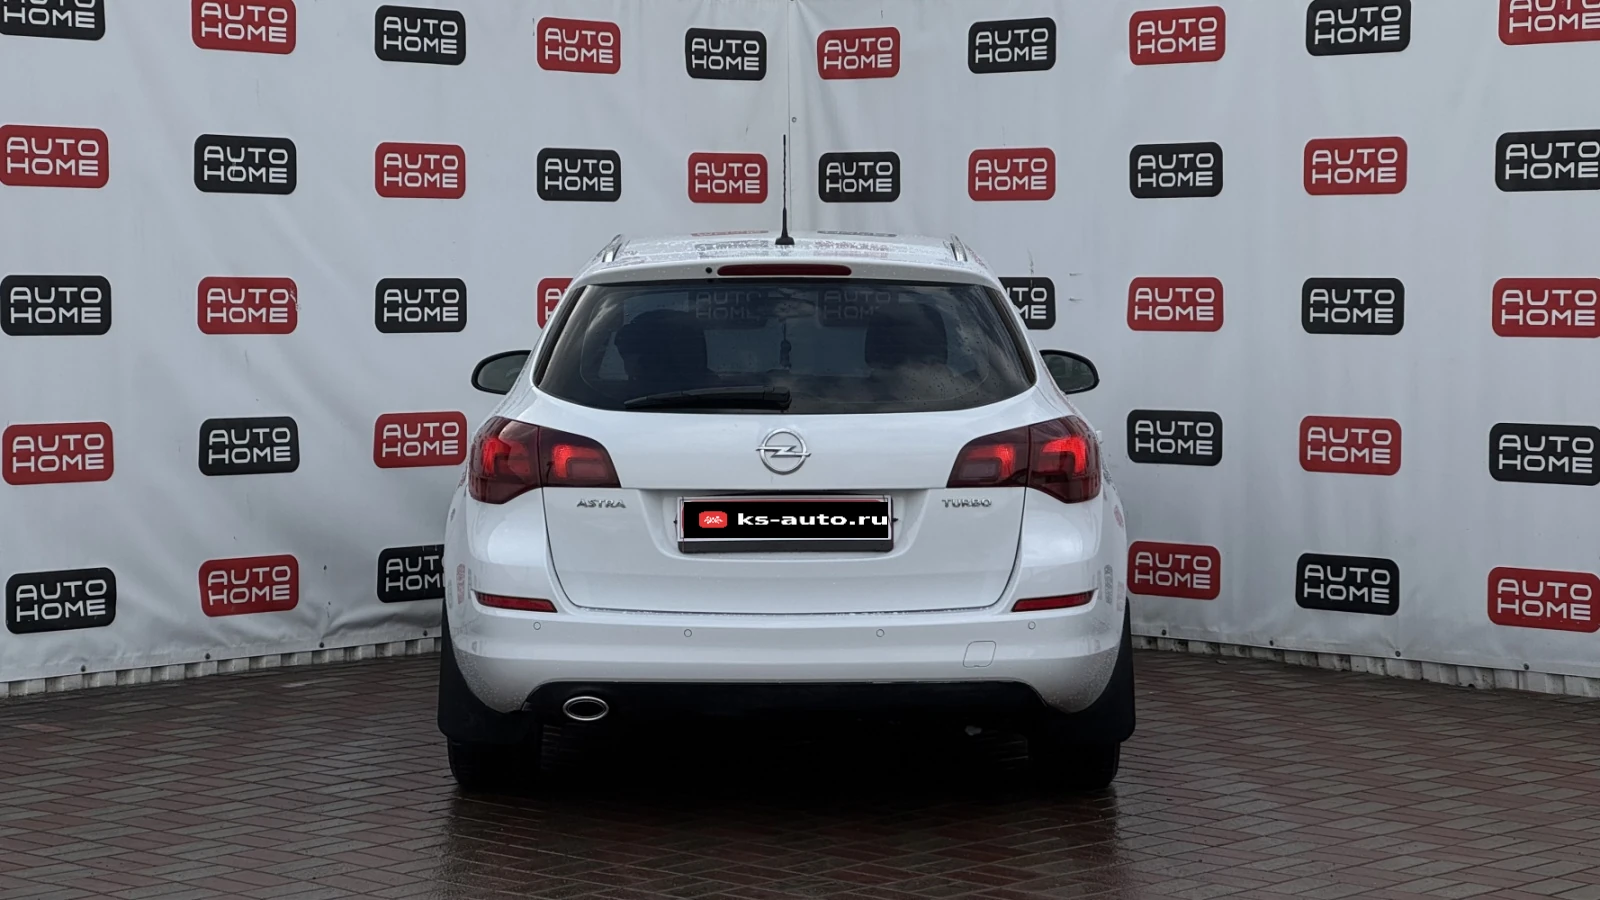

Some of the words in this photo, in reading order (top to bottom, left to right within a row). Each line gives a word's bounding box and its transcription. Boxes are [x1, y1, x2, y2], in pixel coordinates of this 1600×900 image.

[2, 5, 96, 29] HOME
[201, 2, 288, 24] AUTO
[1315, 5, 1402, 26] AUTO
[201, 21, 287, 43] HOME
[383, 16, 458, 36] AUTO
[1137, 17, 1218, 37] AUTO
[1509, 13, 1600, 33] HOME
[544, 27, 614, 47] AUTO
[975, 27, 1049, 46] AUTO
[1314, 24, 1400, 45] HOME
[383, 34, 457, 55] HOME
[691, 37, 760, 55] AUTO
[824, 37, 894, 54] AUTO
[1137, 35, 1216, 55] HOME
[545, 45, 614, 64] HOME
[691, 54, 759, 71] HOME
[823, 53, 892, 70] HOME
[975, 45, 1048, 64] HOME
[6, 136, 100, 157] AUTO
[203, 145, 289, 165] AUTO
[1506, 142, 1600, 159] AUTO
[383, 153, 459, 170] AUTO
[975, 157, 1048, 174] AUTO
[1137, 152, 1214, 170] AUTO
[1312, 147, 1398, 166] AUTO
[6, 156, 99, 177] HOME
[203, 164, 288, 184] HOME
[544, 158, 615, 175] AUTO
[695, 162, 761, 177] AUTO
[826, 161, 893, 176] AUTO
[1311, 166, 1397, 184] HOME
[1505, 161, 1599, 180] HOME
[383, 171, 458, 189] HOME
[544, 175, 614, 192] HOME
[695, 179, 760, 194] HOME
[825, 178, 892, 193] HOME
[975, 175, 1047, 191] HOME
[1137, 171, 1213, 188] HOME
[10, 286, 102, 304] AUTO
[207, 288, 289, 304] AUTO
[383, 288, 460, 304] AUTO
[824, 289, 892, 303] AUTO
[1006, 287, 1048, 302] TO
[1135, 287, 1215, 303] AUTO
[1310, 288, 1395, 305] AUTO
[1501, 289, 1597, 307] AUTO
[10, 307, 101, 324] HOME
[207, 307, 288, 323] HOME
[383, 306, 459, 323] HOME
[1013, 304, 1047, 320] ME
[1134, 305, 1214, 321] HOME
[1309, 307, 1394, 324] HOME
[1501, 309, 1596, 326] HOME
[209, 427, 291, 446] AUTO
[383, 421, 460, 440] AUTO
[1135, 420, 1214, 437] AUTO
[1307, 426, 1392, 445] AUTO
[12, 433, 105, 453] AUTO
[382, 439, 459, 458] HOME
[1135, 437, 1213, 455] HOME
[1499, 434, 1594, 454] AUTO
[12, 453, 104, 473] HOME
[208, 446, 291, 465] HOME
[1307, 445, 1391, 464] HOME
[1498, 453, 1593, 474] HOME
[576, 499, 626, 509] ASTRA
[941, 499, 992, 508] TURBO
[385, 555, 444, 574] AUT
[1134, 550, 1213, 572] AUTO
[207, 565, 291, 587] AUTO
[385, 573, 445, 592] HOM
[1133, 568, 1212, 590] HOME
[1304, 564, 1390, 585] AUTO
[16, 579, 107, 602] AUTO
[208, 584, 290, 606] HOME
[1304, 582, 1389, 604] HOME
[1497, 578, 1592, 601] AUTO
[16, 598, 106, 622] HOME
[1497, 597, 1591, 621] HOME
